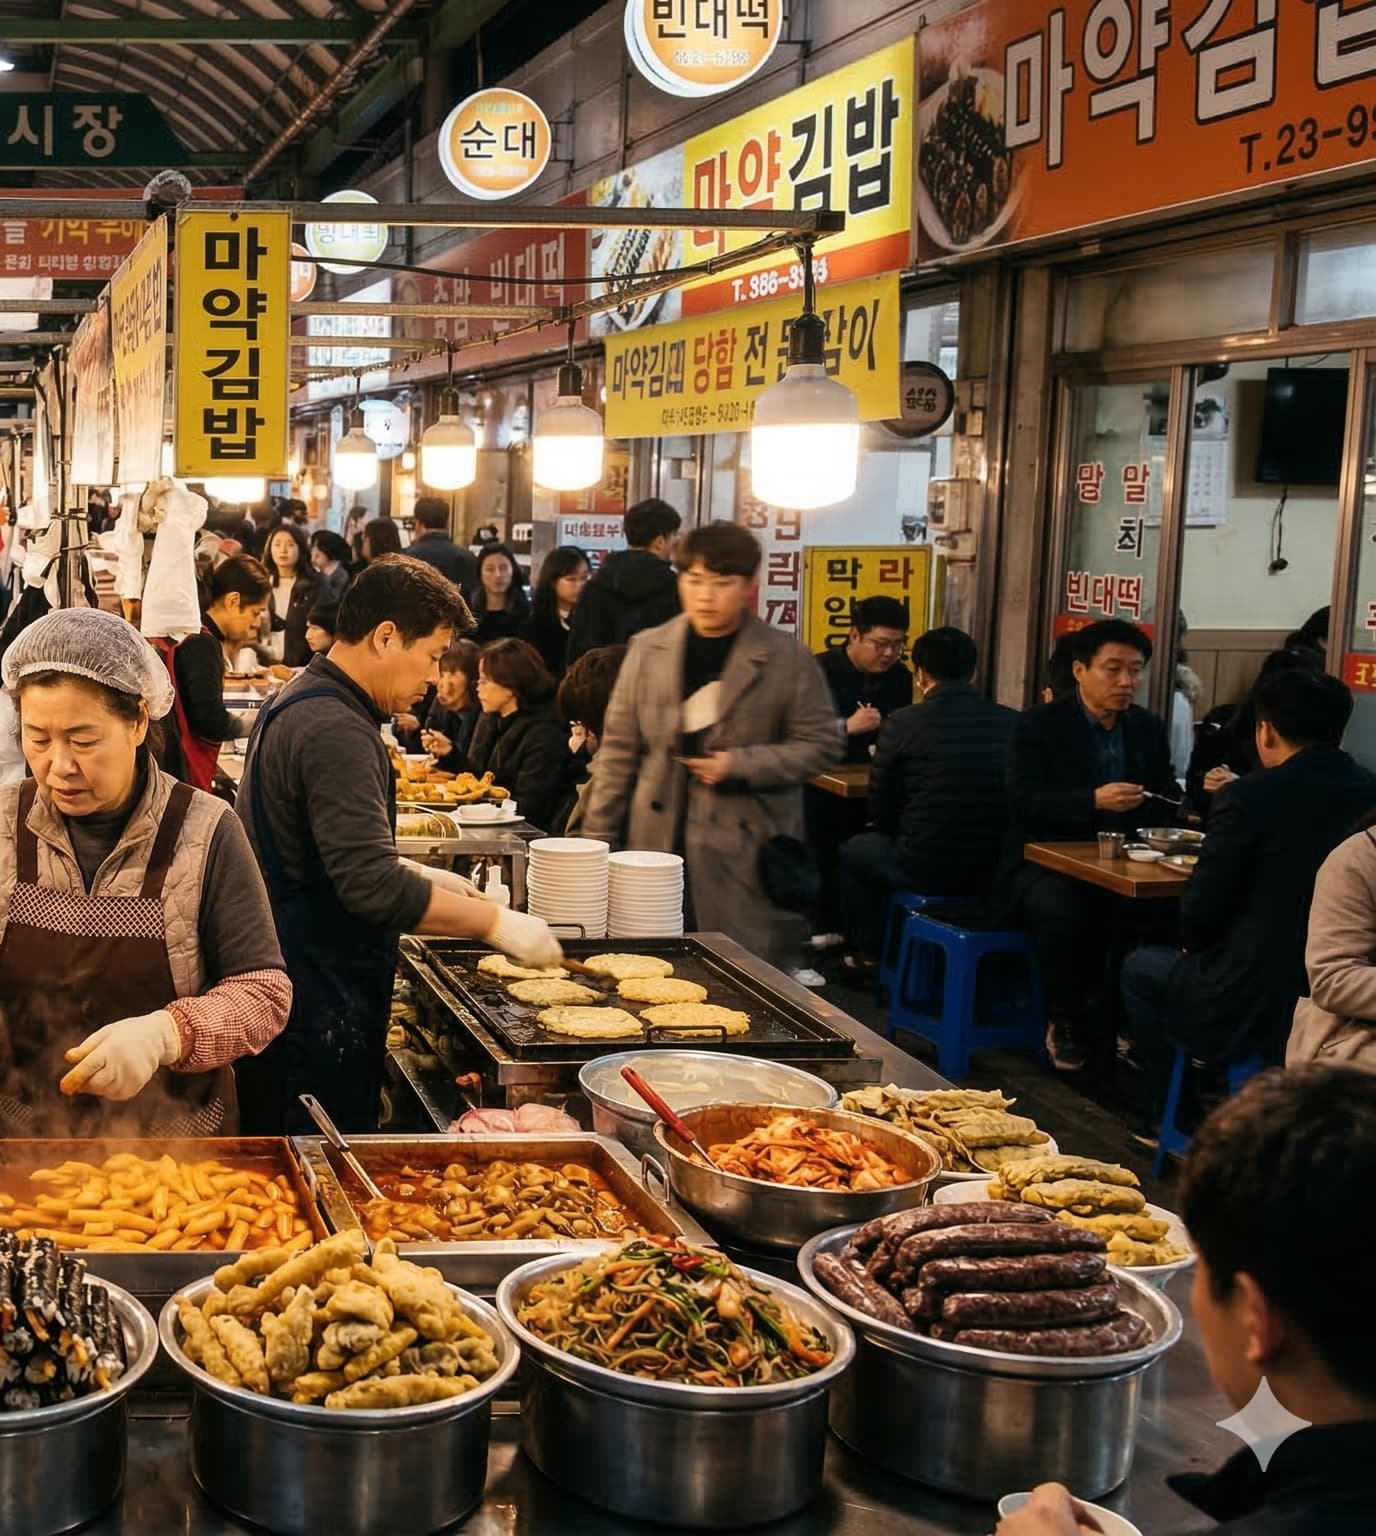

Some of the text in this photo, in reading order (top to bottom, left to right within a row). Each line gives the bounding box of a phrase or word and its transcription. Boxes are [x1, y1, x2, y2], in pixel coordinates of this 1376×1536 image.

[652, 0, 771, 40] 빈대떡
[459, 120, 536, 160] 순대
[1239, 104, 1376, 175] T.23-9
[201, 227, 269, 460] 마약김밥
[693, 328, 737, 395] 당함
[879, 557, 914, 590] 라
[1067, 571, 1143, 620] 빈대떡
